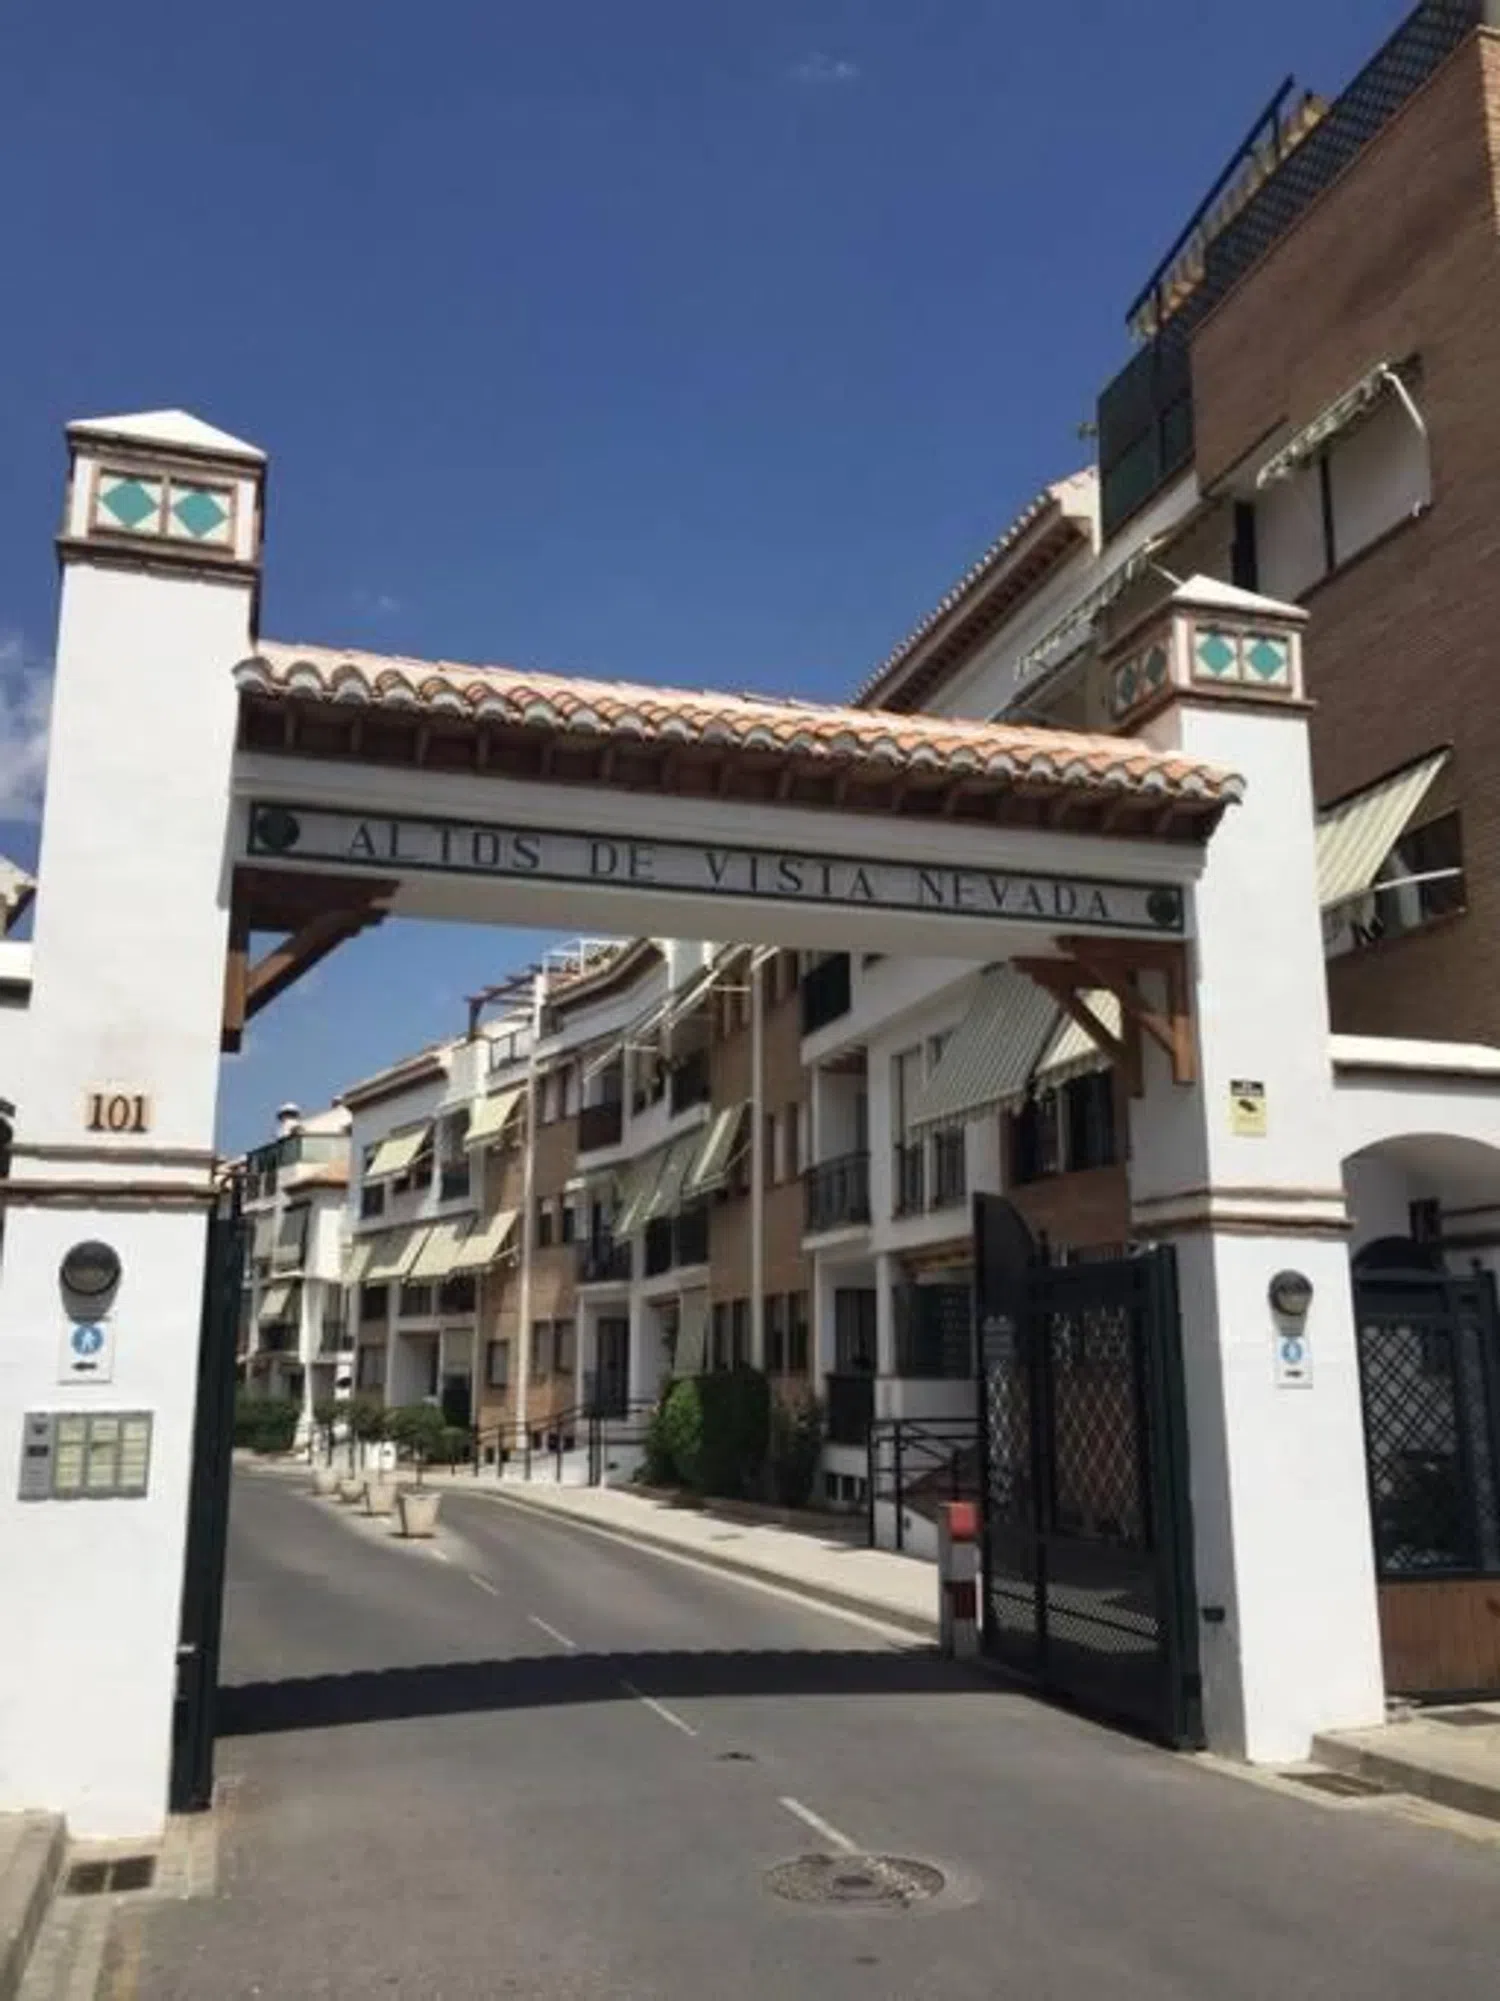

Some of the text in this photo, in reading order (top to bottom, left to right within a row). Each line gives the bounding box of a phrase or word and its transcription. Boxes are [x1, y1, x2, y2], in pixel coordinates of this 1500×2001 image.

[348, 820, 1111, 919] ALTOS DE VISTA NEVADA
[86, 1093, 148, 1133] 101
